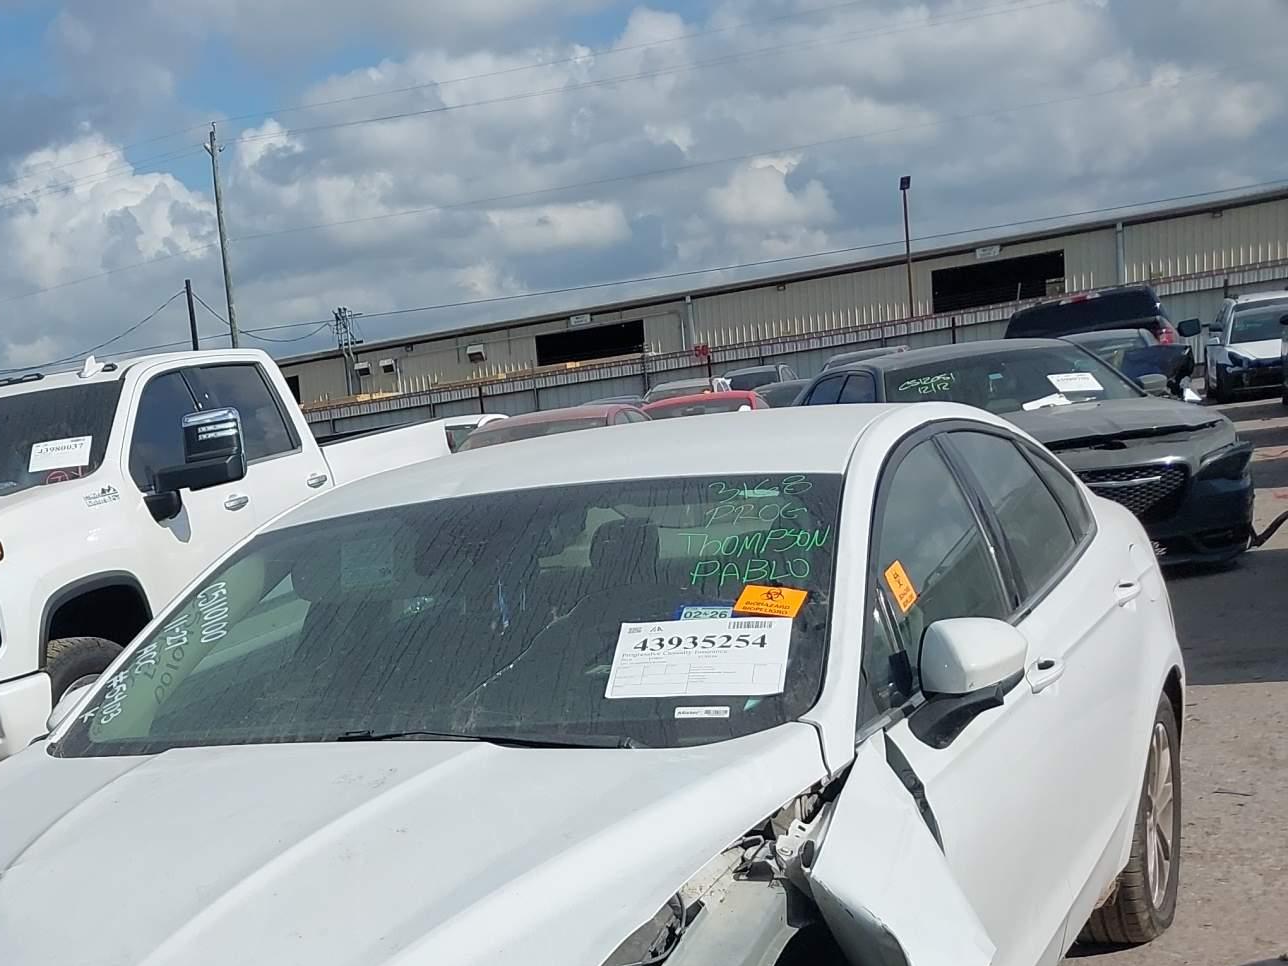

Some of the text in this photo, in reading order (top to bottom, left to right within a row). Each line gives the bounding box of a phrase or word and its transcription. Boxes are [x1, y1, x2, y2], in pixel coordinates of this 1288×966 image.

[690, 558, 810, 586] PABLO
[745, 600, 791, 610] BIOHAZARD
[633, 634, 767, 652] 43935254
